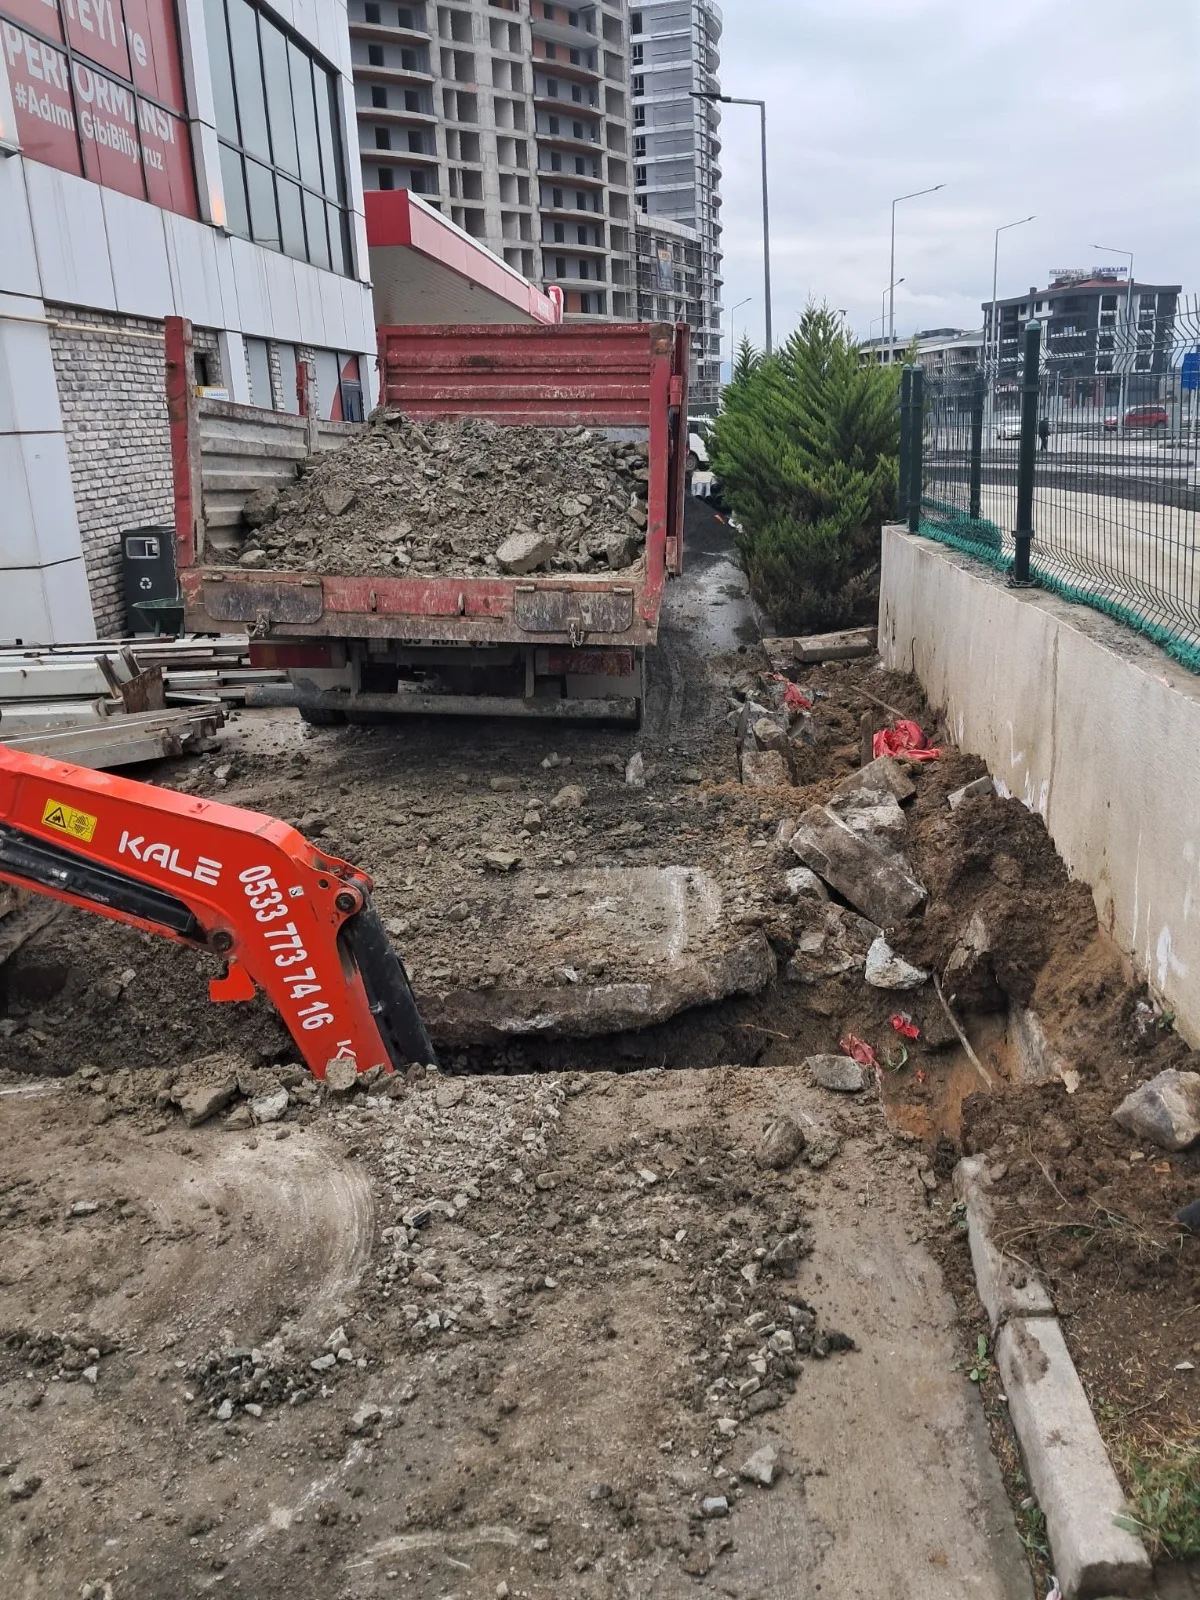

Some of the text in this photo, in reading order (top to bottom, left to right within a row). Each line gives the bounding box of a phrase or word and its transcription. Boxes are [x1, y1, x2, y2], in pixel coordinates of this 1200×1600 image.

[119, 830, 222, 886] KALE
[238, 865, 334, 1030] 0533 773 74 16
